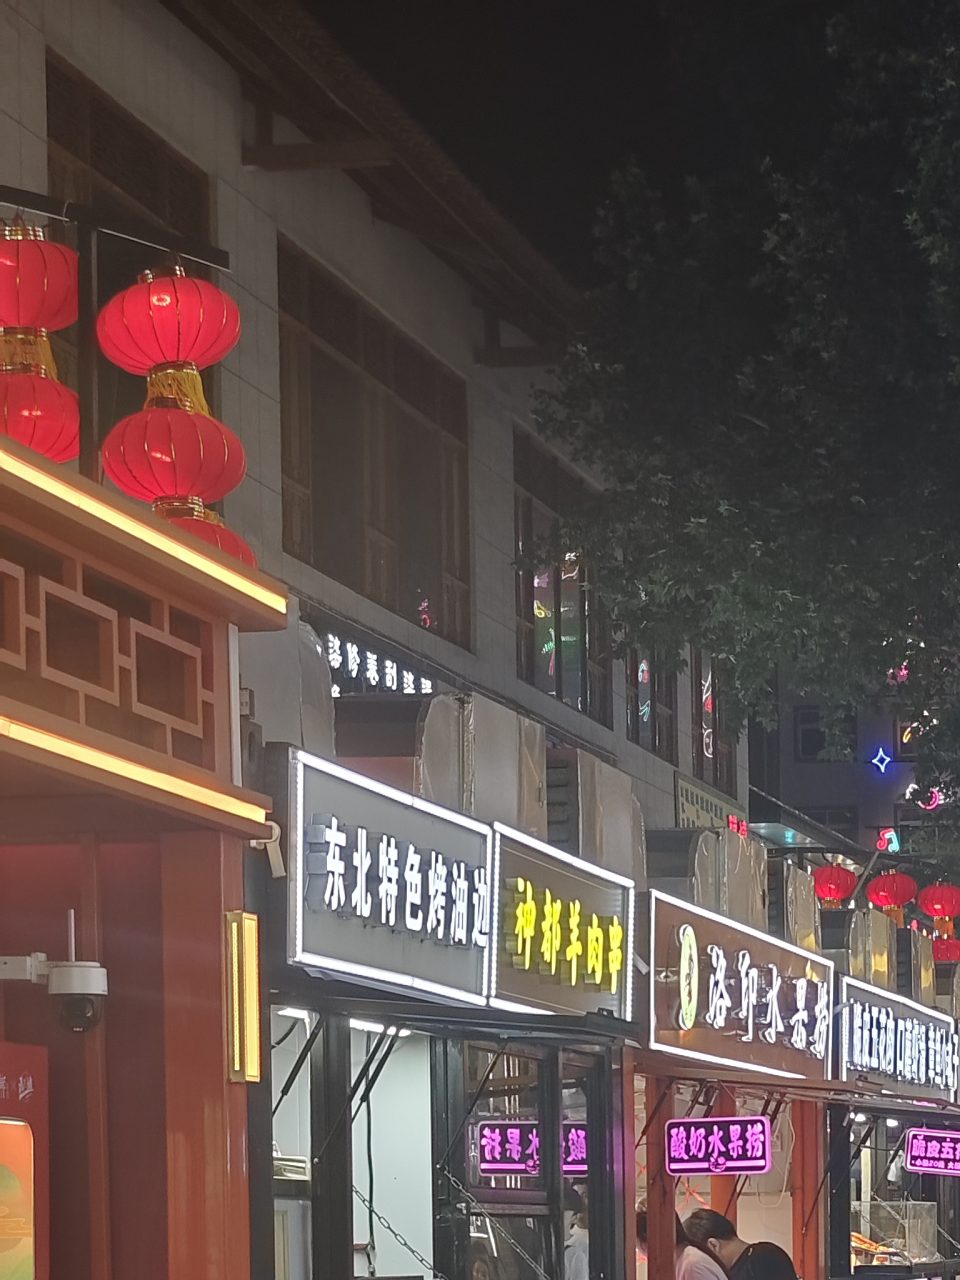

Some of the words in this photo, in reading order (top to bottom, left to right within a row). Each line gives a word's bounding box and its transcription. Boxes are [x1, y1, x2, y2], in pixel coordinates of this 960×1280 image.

[324, 815, 489, 949] 东北特色烤油边
[514, 876, 624, 995] 神都羊肉串
[669, 1121, 765, 1161] 酸奶水果捞
